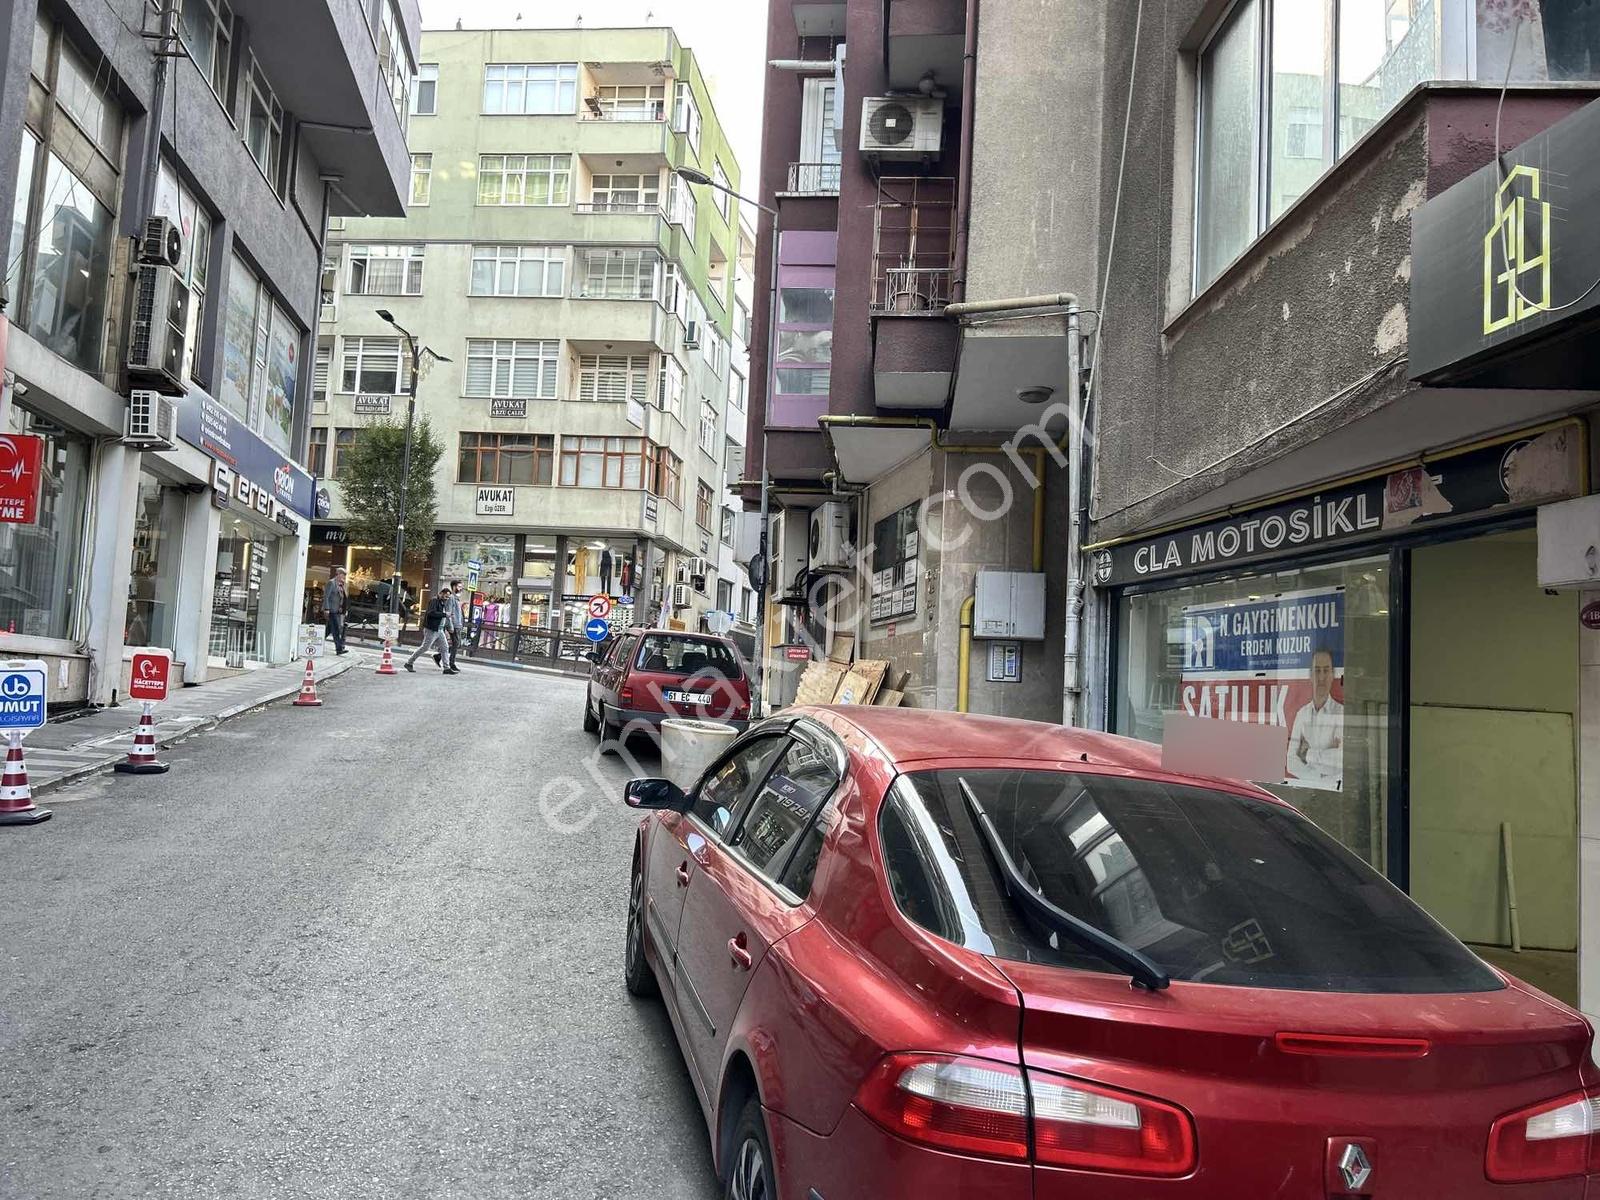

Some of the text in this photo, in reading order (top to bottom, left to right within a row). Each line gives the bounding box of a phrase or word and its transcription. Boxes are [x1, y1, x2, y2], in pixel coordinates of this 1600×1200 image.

[356, 396, 389, 405] AVUKAT
[493, 400, 525, 409] AVUKAT
[478, 489, 513, 502] AVUKAT
[1134, 476, 1442, 574] CLA MOTOSİKL
[1240, 635, 1311, 656] ERDEM KUZUR
[668, 691, 711, 704] 61 EC 440
[1182, 685, 1289, 728] SATILIK
